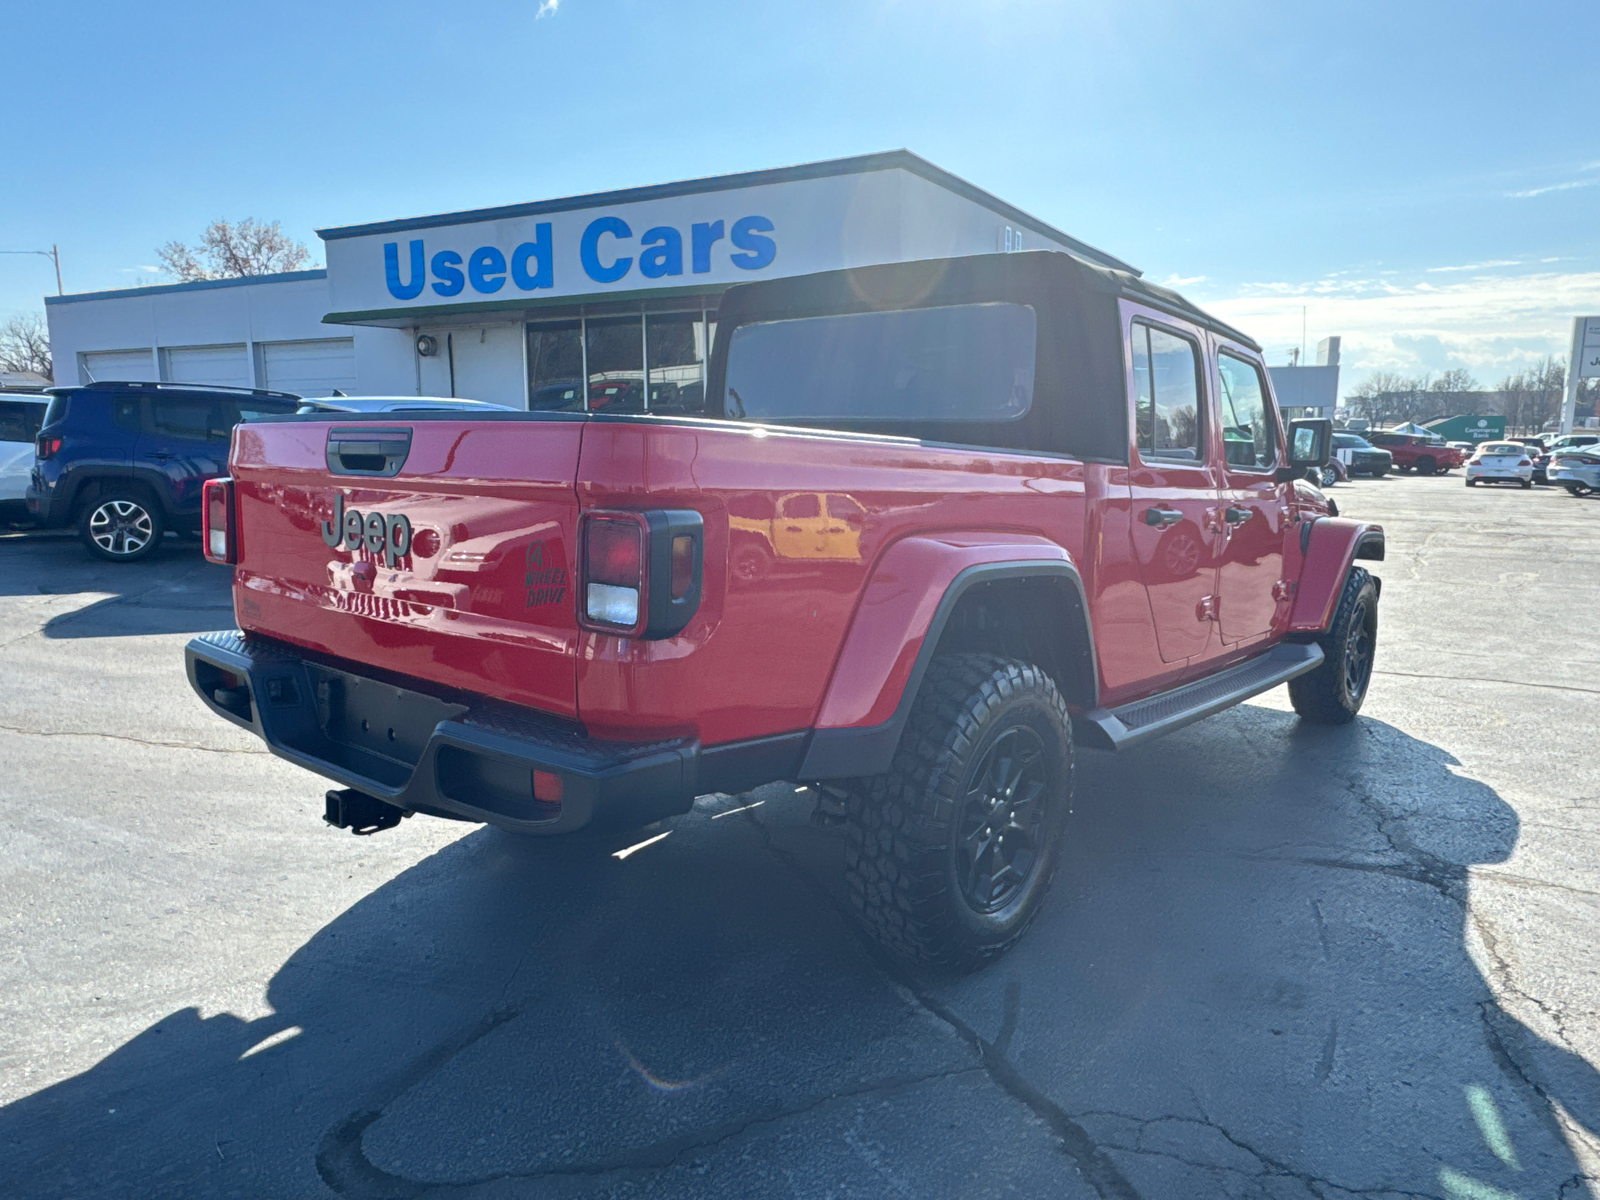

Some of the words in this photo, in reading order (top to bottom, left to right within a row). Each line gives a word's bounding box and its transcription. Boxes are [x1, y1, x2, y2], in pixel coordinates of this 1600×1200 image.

[383, 222, 555, 301] Used
[580, 215, 777, 284] Cars
[321, 494, 412, 568] Jeep
[531, 545, 543, 567] 4
[525, 568, 566, 587] WHEEL
[526, 587, 565, 608] DRIVE
